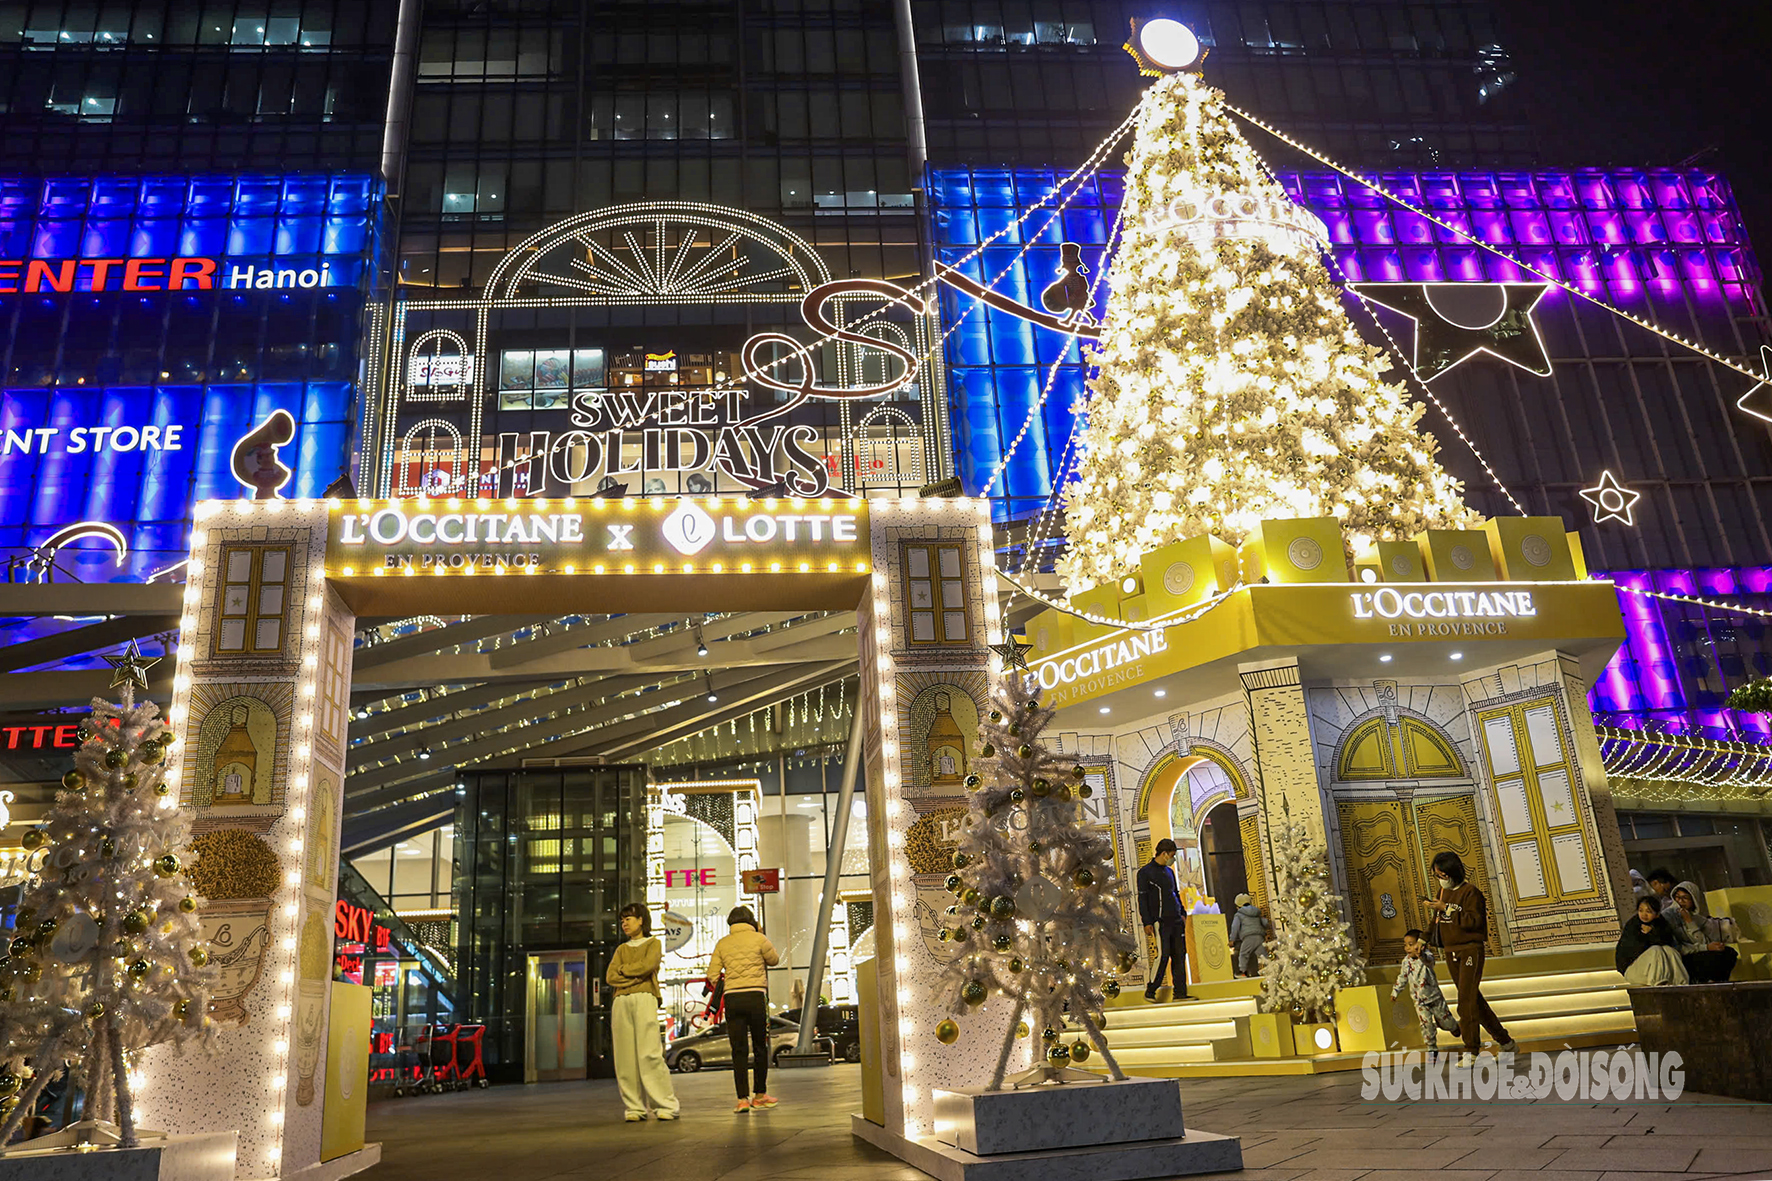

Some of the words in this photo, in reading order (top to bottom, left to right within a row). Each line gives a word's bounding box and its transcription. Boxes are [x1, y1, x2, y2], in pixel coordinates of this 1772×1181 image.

[230, 262, 330, 289] Hanoi
[570, 390, 749, 427] SWEET
[0, 427, 59, 455] NT
[66, 425, 183, 453] STORE
[497, 425, 830, 499] HOLIDAYS
[340, 508, 583, 545] L'OCCITANE
[723, 514, 858, 543] LOTTE
[384, 554, 413, 569] EN
[421, 553, 540, 569] PROVENCE
[1350, 588, 1537, 619] L'OCCITANE
[1388, 623, 1413, 637] EN
[1418, 621, 1508, 636] PROVENCE
[1023, 627, 1168, 695] L'OCCITANE
[1050, 690, 1067, 703] EN
[1072, 664, 1145, 698] PROVENCE
[0, 725, 78, 750] TTE
[335, 899, 374, 944] SKY
